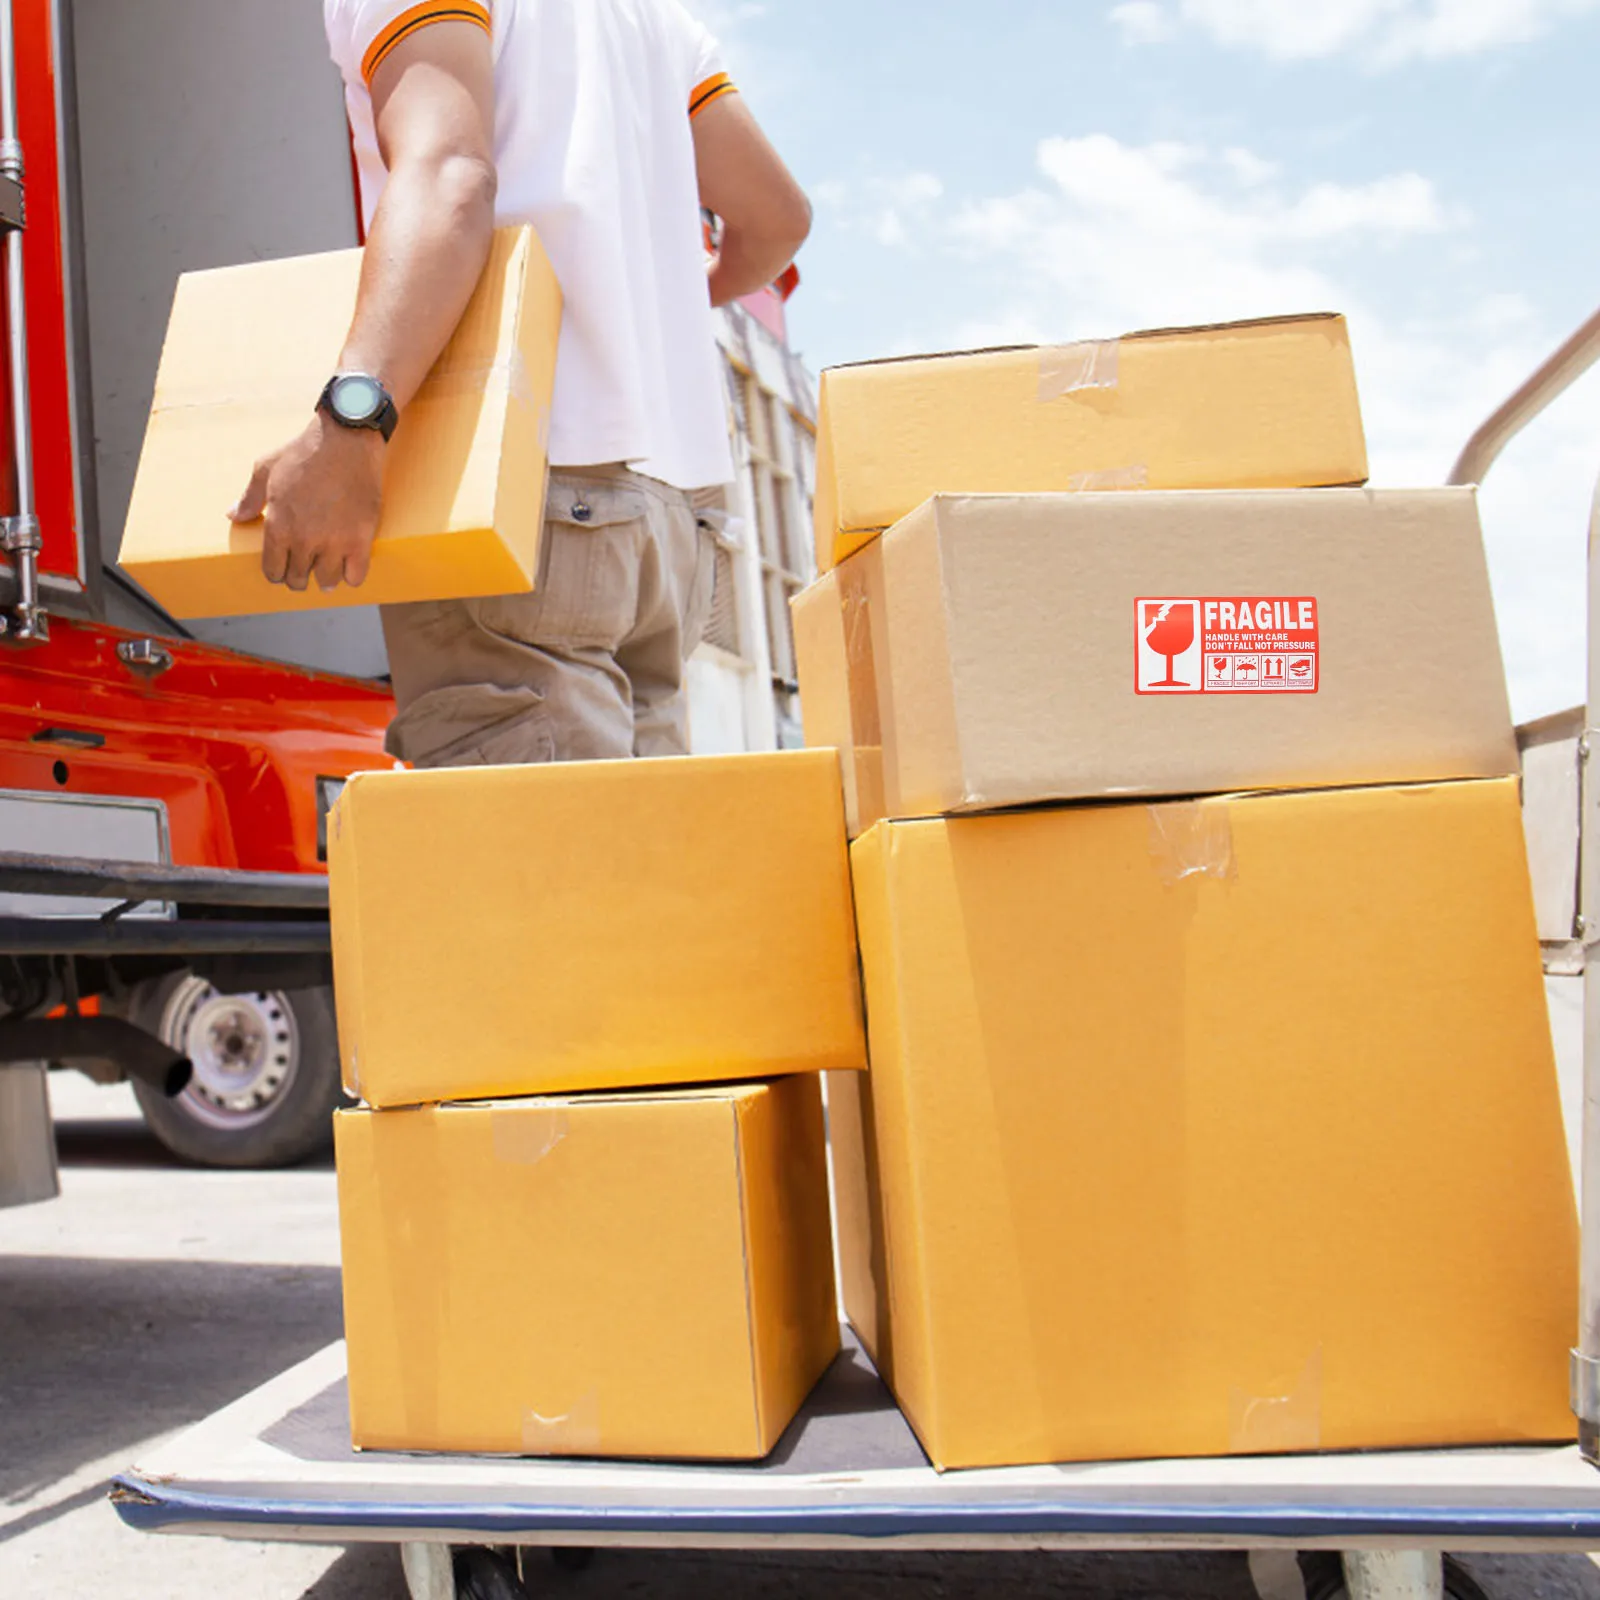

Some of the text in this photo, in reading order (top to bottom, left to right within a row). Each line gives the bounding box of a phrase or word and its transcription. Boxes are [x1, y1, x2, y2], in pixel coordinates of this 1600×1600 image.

[1204, 600, 1314, 630] FRAGILE
[1205, 633, 1288, 641] HANDLE WITH CARE
[1205, 641, 1316, 650] DON'T FALL NOT PRESSURE
